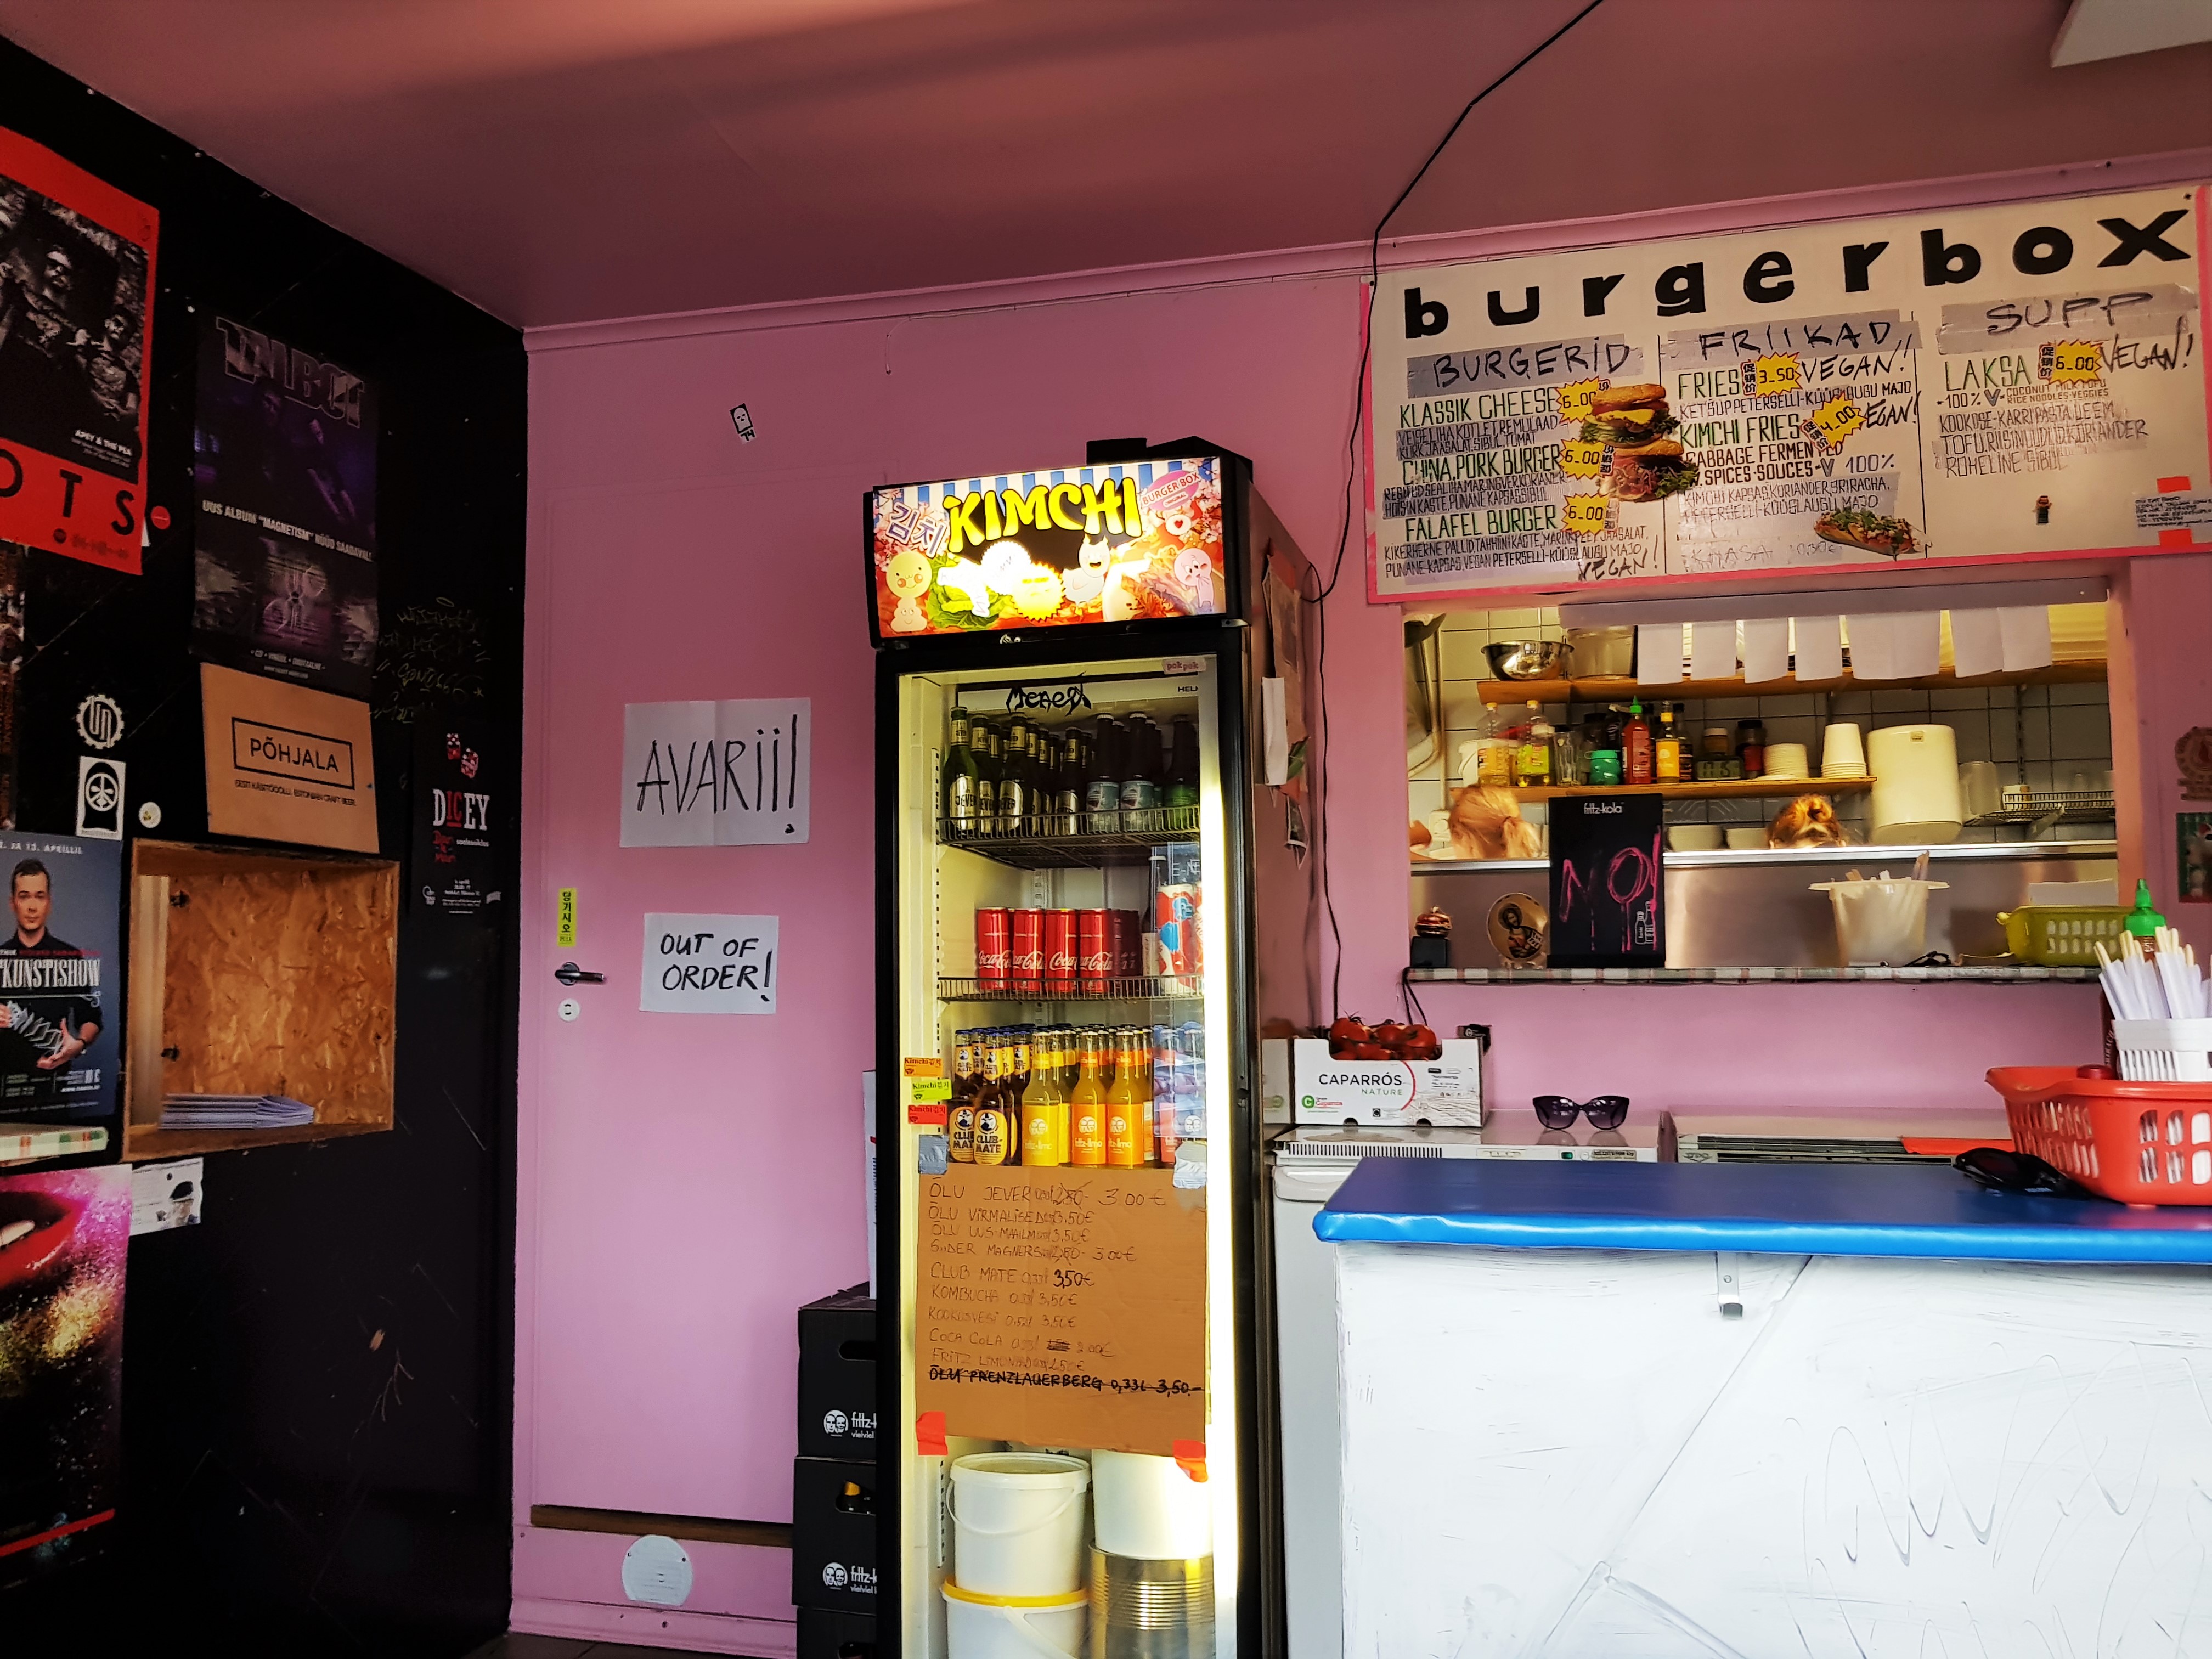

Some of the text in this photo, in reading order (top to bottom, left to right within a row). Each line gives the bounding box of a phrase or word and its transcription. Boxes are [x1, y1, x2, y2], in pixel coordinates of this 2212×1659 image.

[1404, 210, 2191, 339] burgerbox
[1987, 292, 2153, 335] SUPP
[1678, 369, 1739, 399] FRIES
[1945, 356, 2031, 392] LAKSA
[1882, 381, 1911, 396] MAJO
[2007, 384, 2051, 397] COCONUT
[2007, 394, 2027, 404] RICE
[1400, 387, 1560, 428] KLASSIK CHEESE
[1680, 414, 1800, 448] KIMCHI FRIES
[1457, 444, 1562, 479] PORK BURGER
[1846, 453, 1895, 474] 100%
[1946, 451, 2021, 478] ROHELINE
[1142, 472, 1200, 505] BURGER BOX
[224, 505, 257, 524] ALBUM
[941, 476, 1143, 554] KIMCHI
[1405, 504, 1558, 541] FALAFEL BURGER
[887, 503, 947, 558] 김치
[250, 736, 339, 773] PÕHJALA
[432, 788, 490, 831] DICEY
[1583, 802, 1624, 815] fritz-kola
[661, 933, 759, 957] OUT OF
[662, 948, 773, 1002] ORDER!
[1318, 1071, 1403, 1086] CAPARRÓS
[1361, 1088, 1403, 1096] NATURE
[975, 1144, 1001, 1153] MATE
[983, 1186, 1031, 1201] JEVER
[930, 1262, 970, 1280] CLUB
[980, 1267, 1018, 1283] MATE
[932, 1284, 999, 1301] KOMBUCHA
